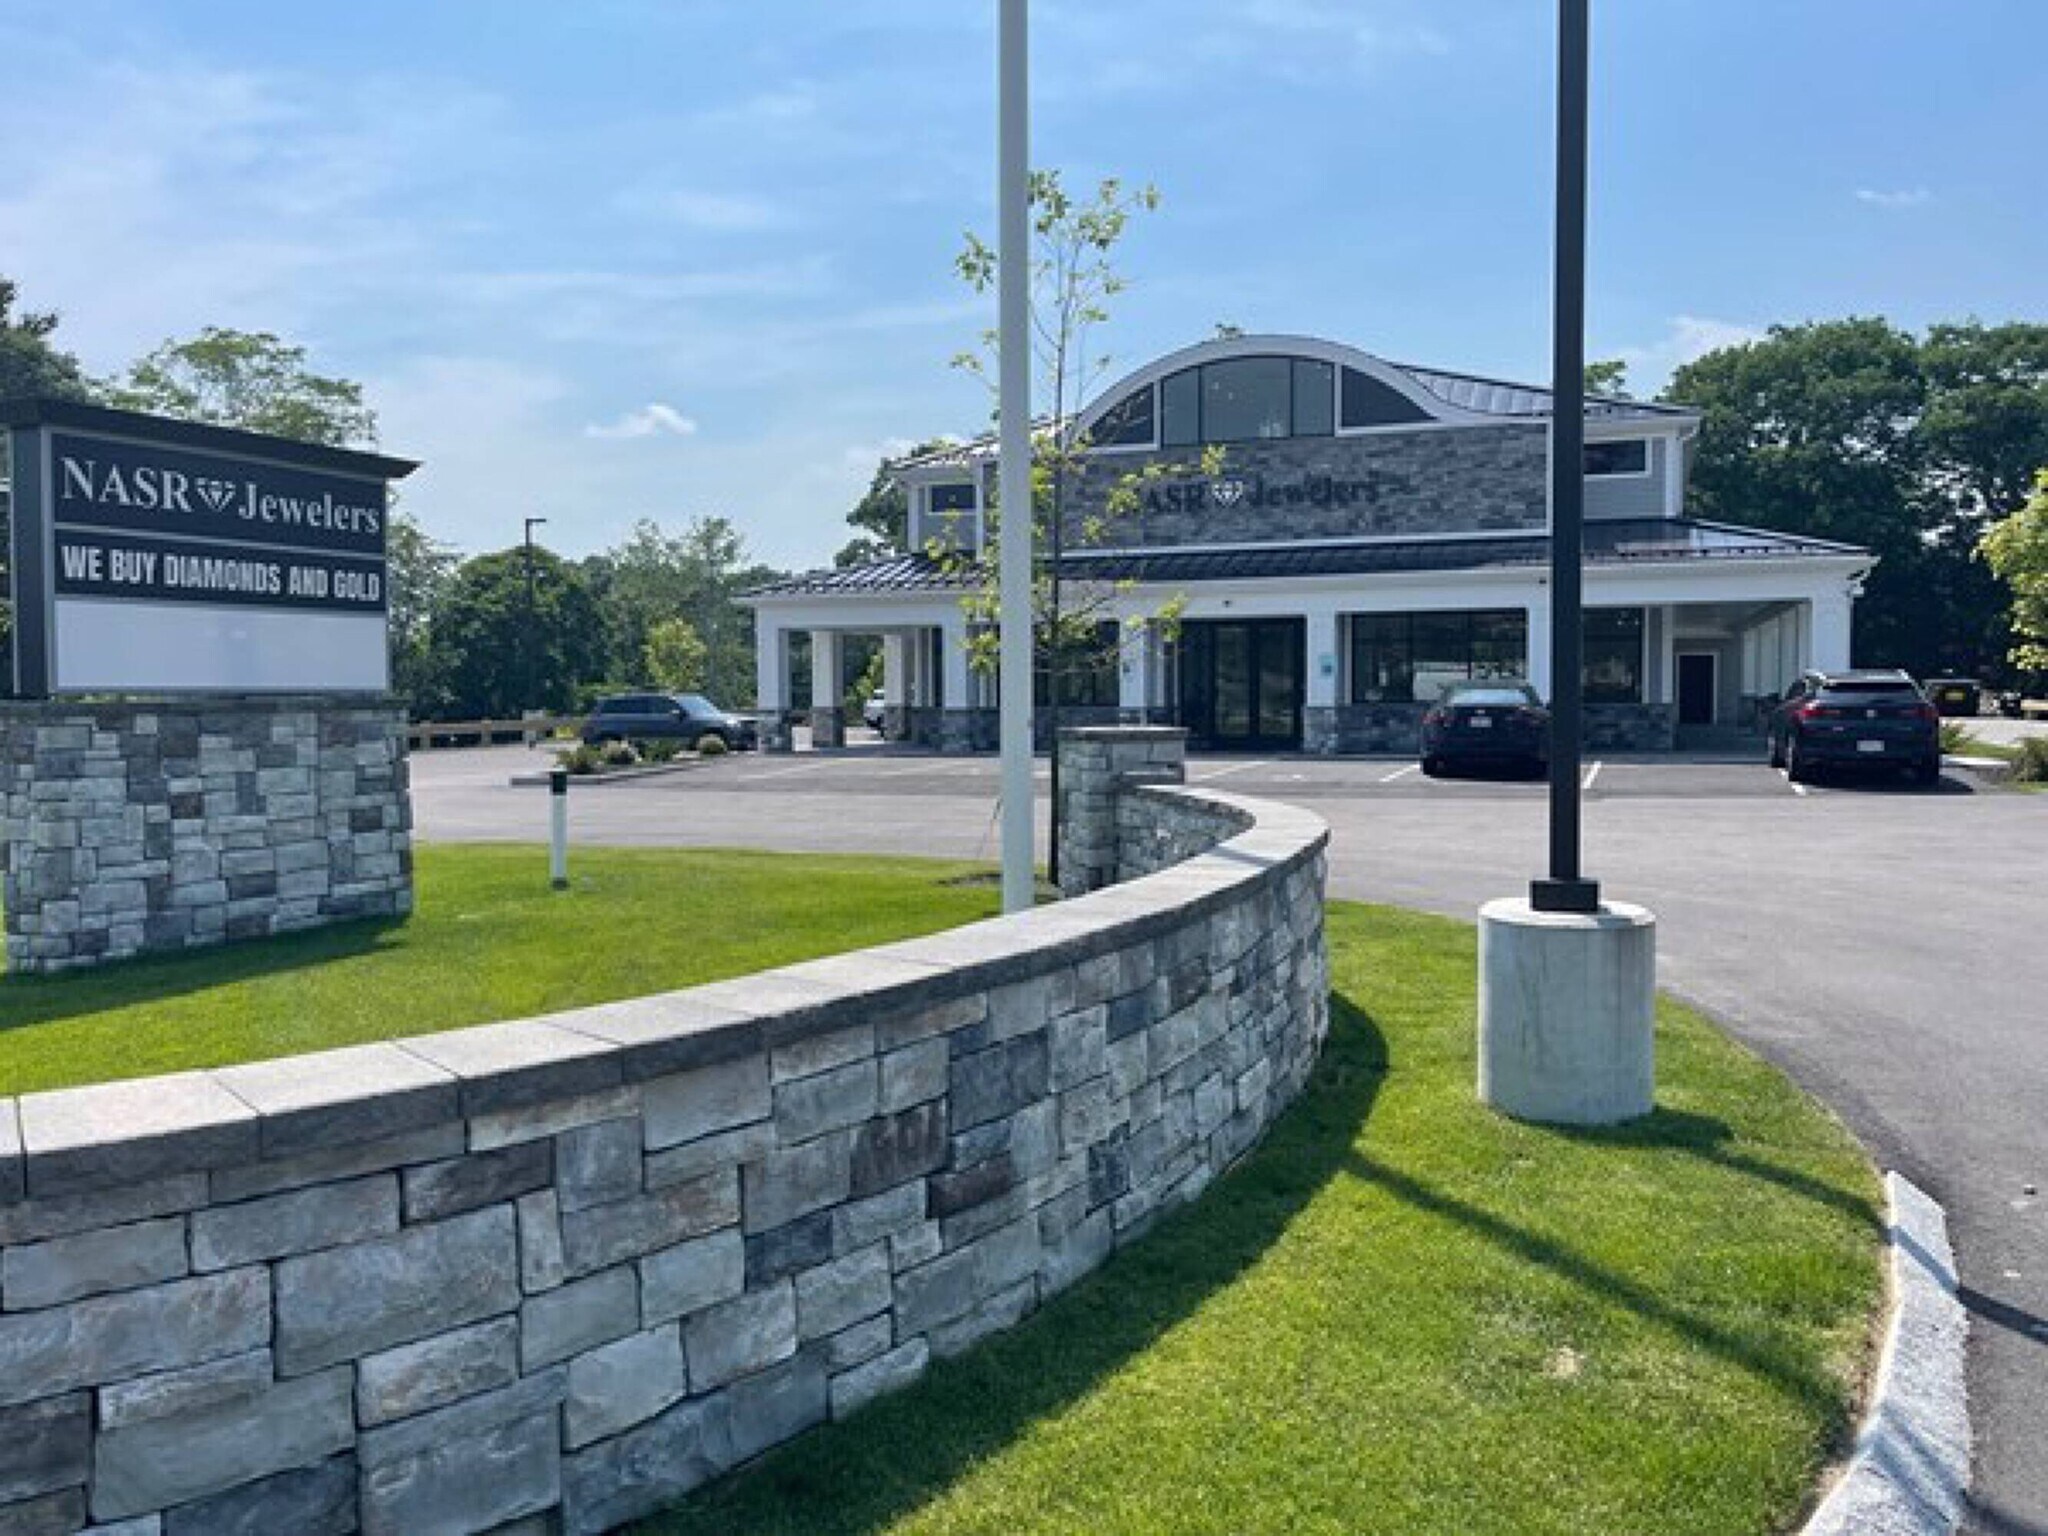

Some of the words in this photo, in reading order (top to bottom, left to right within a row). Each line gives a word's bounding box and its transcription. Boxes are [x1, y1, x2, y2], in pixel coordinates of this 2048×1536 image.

[60, 456, 193, 513] NASR
[238, 481, 380, 534] Jewelers
[1124, 481, 1207, 513] ASR
[61, 545, 103, 582] WE
[109, 549, 157, 585] BUY
[164, 555, 281, 594] DIAMONDS
[288, 567, 328, 598] AND
[333, 570, 380, 601] GOLD
